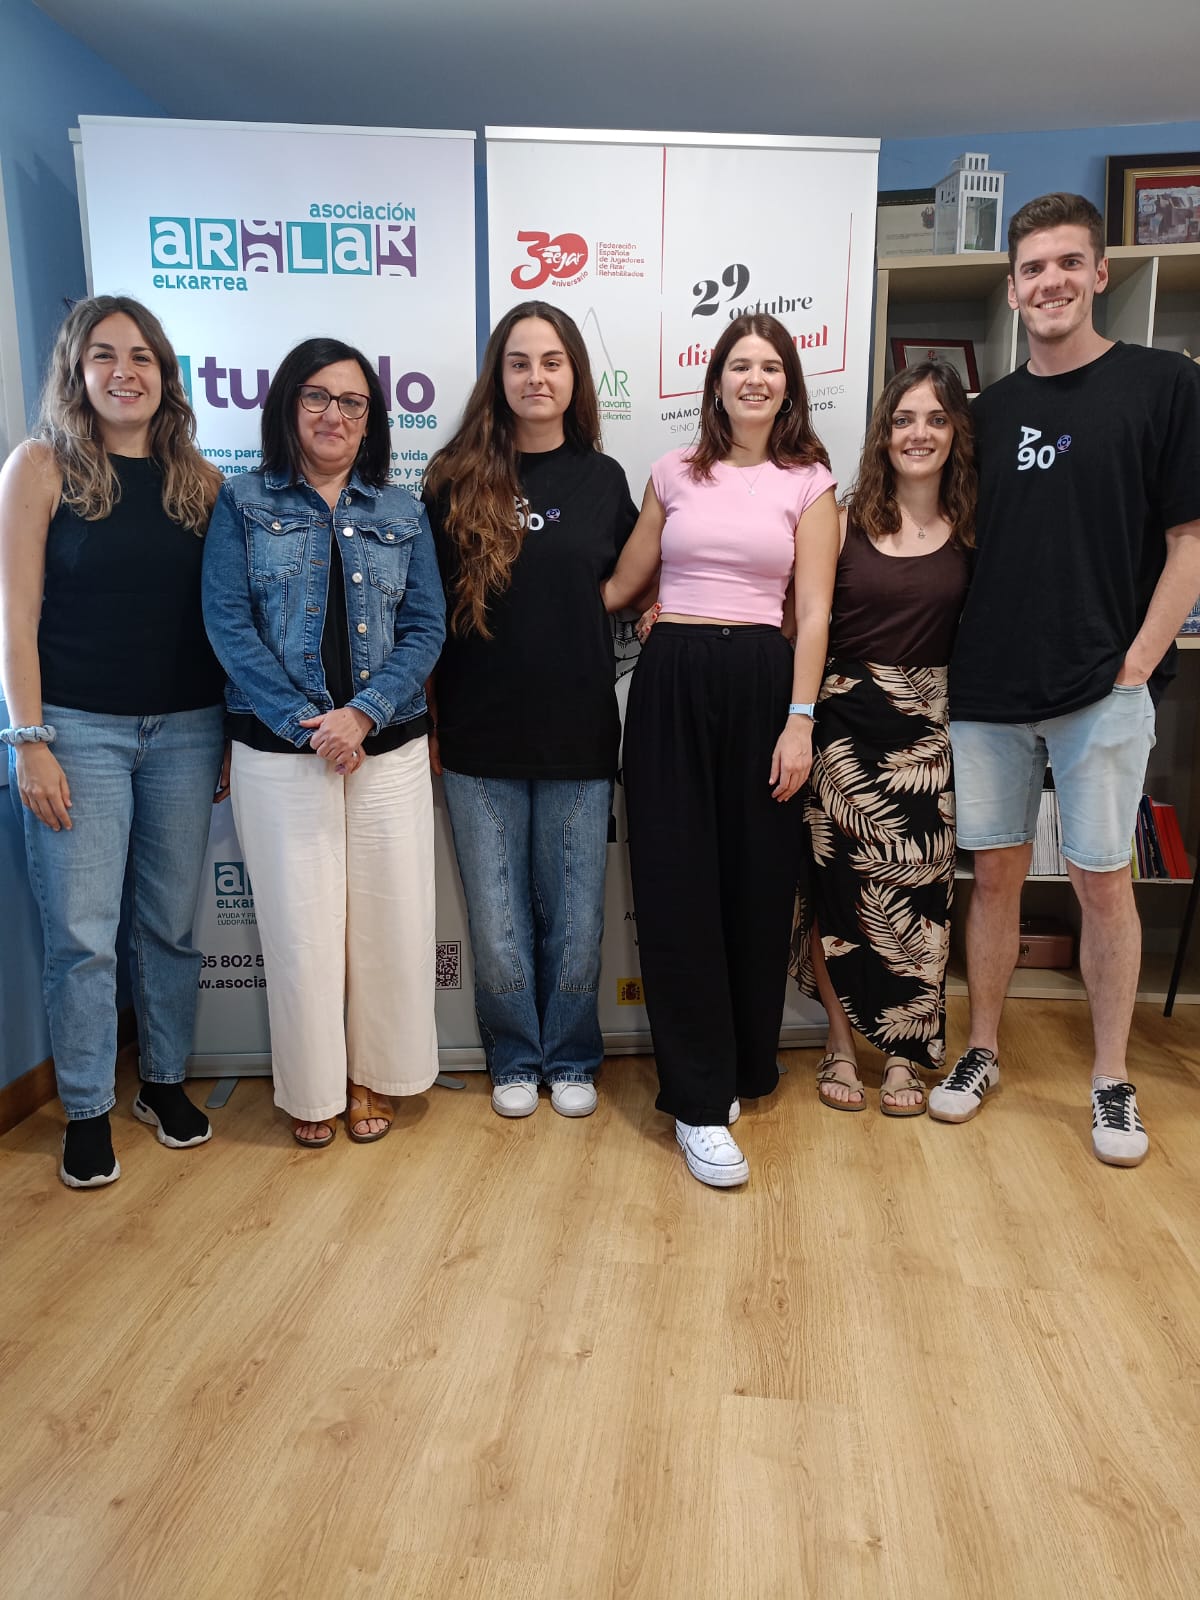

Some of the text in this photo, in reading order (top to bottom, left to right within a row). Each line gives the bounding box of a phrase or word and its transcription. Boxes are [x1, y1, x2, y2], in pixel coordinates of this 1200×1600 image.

[551, 271, 589, 287] aniversario
[691, 263, 750, 319] 29
[729, 295, 813, 321] octubre
[398, 413, 437, 429] 1996
[661, 408, 703, 420] UNÁMO
[670, 422, 695, 434] SINO
[400, 449, 428, 460] vida
[1017, 445, 1056, 471] 90
[404, 468, 412, 479] y
[221, 954, 253, 968] 802
